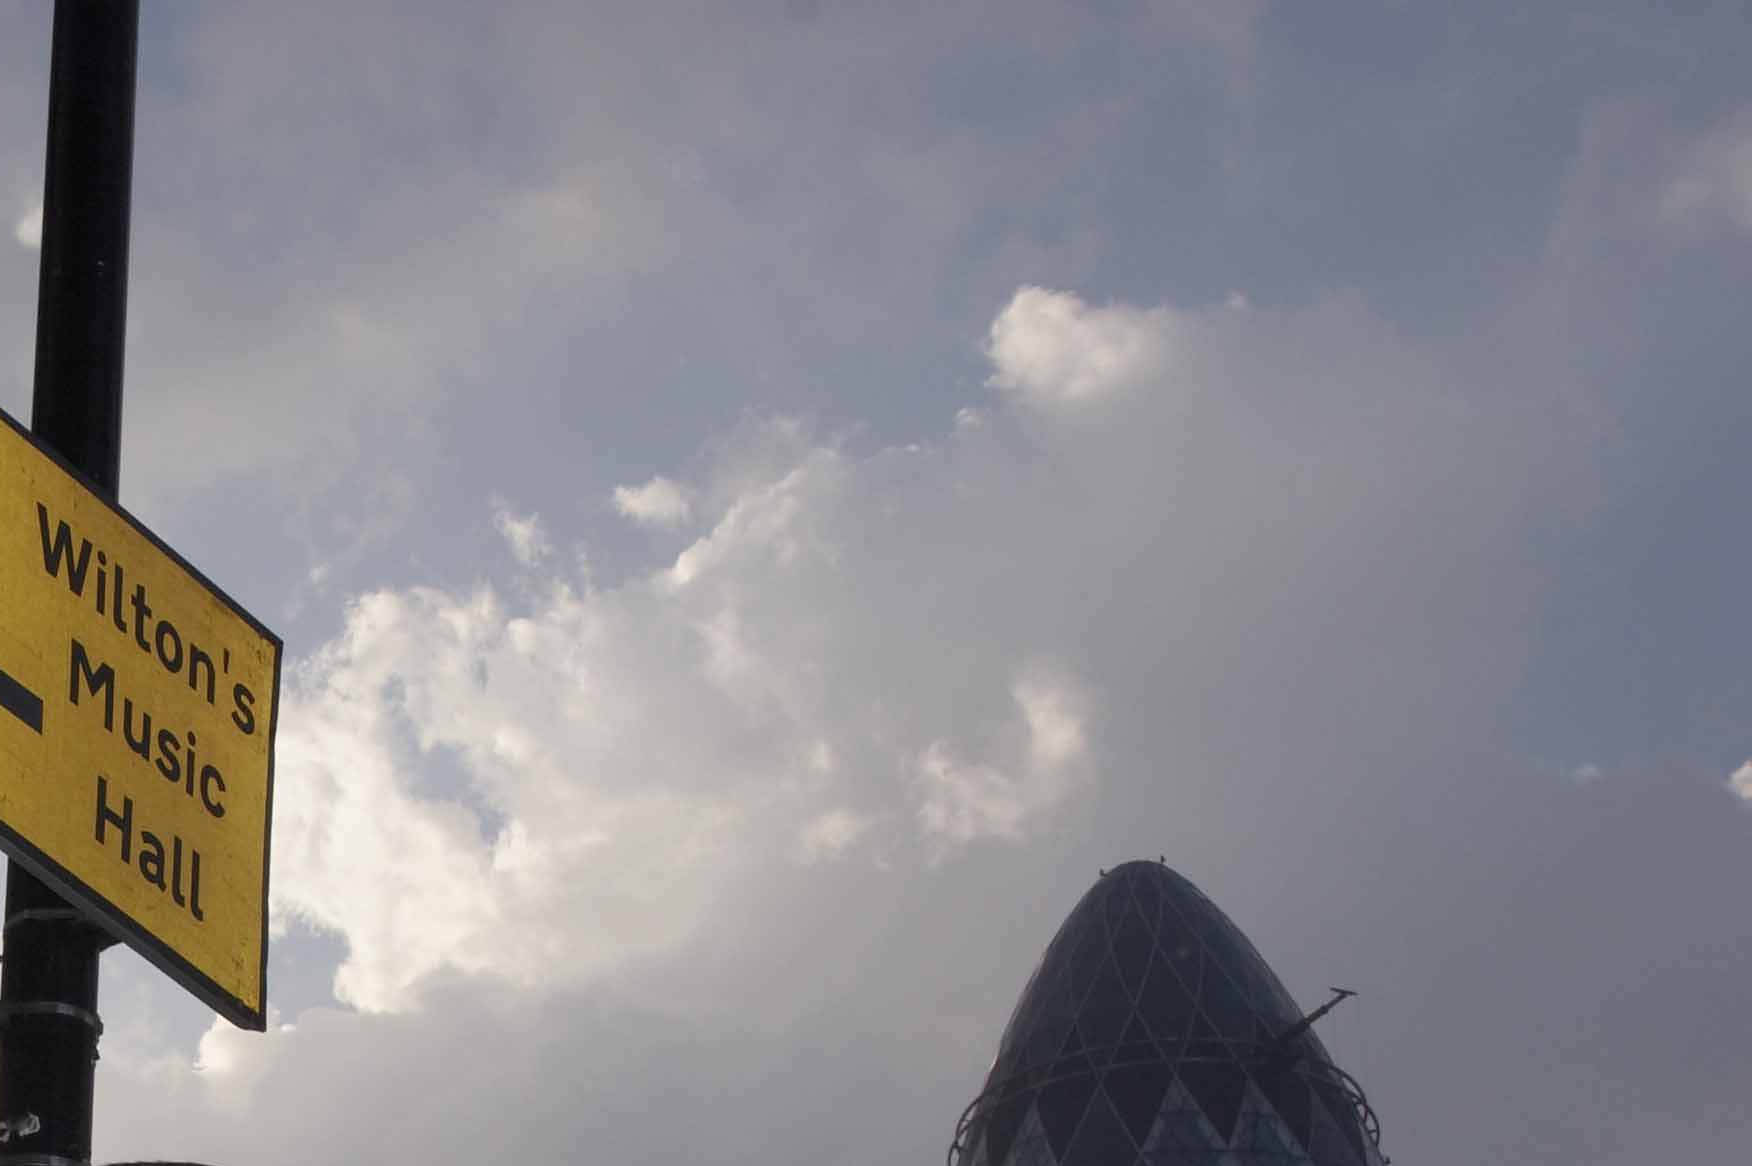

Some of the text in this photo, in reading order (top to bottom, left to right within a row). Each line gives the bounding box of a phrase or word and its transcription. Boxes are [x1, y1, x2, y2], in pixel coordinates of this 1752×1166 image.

[37, 502, 256, 737] Wilton's
[69, 639, 226, 819] Music
[94, 775, 204, 922] Hall
